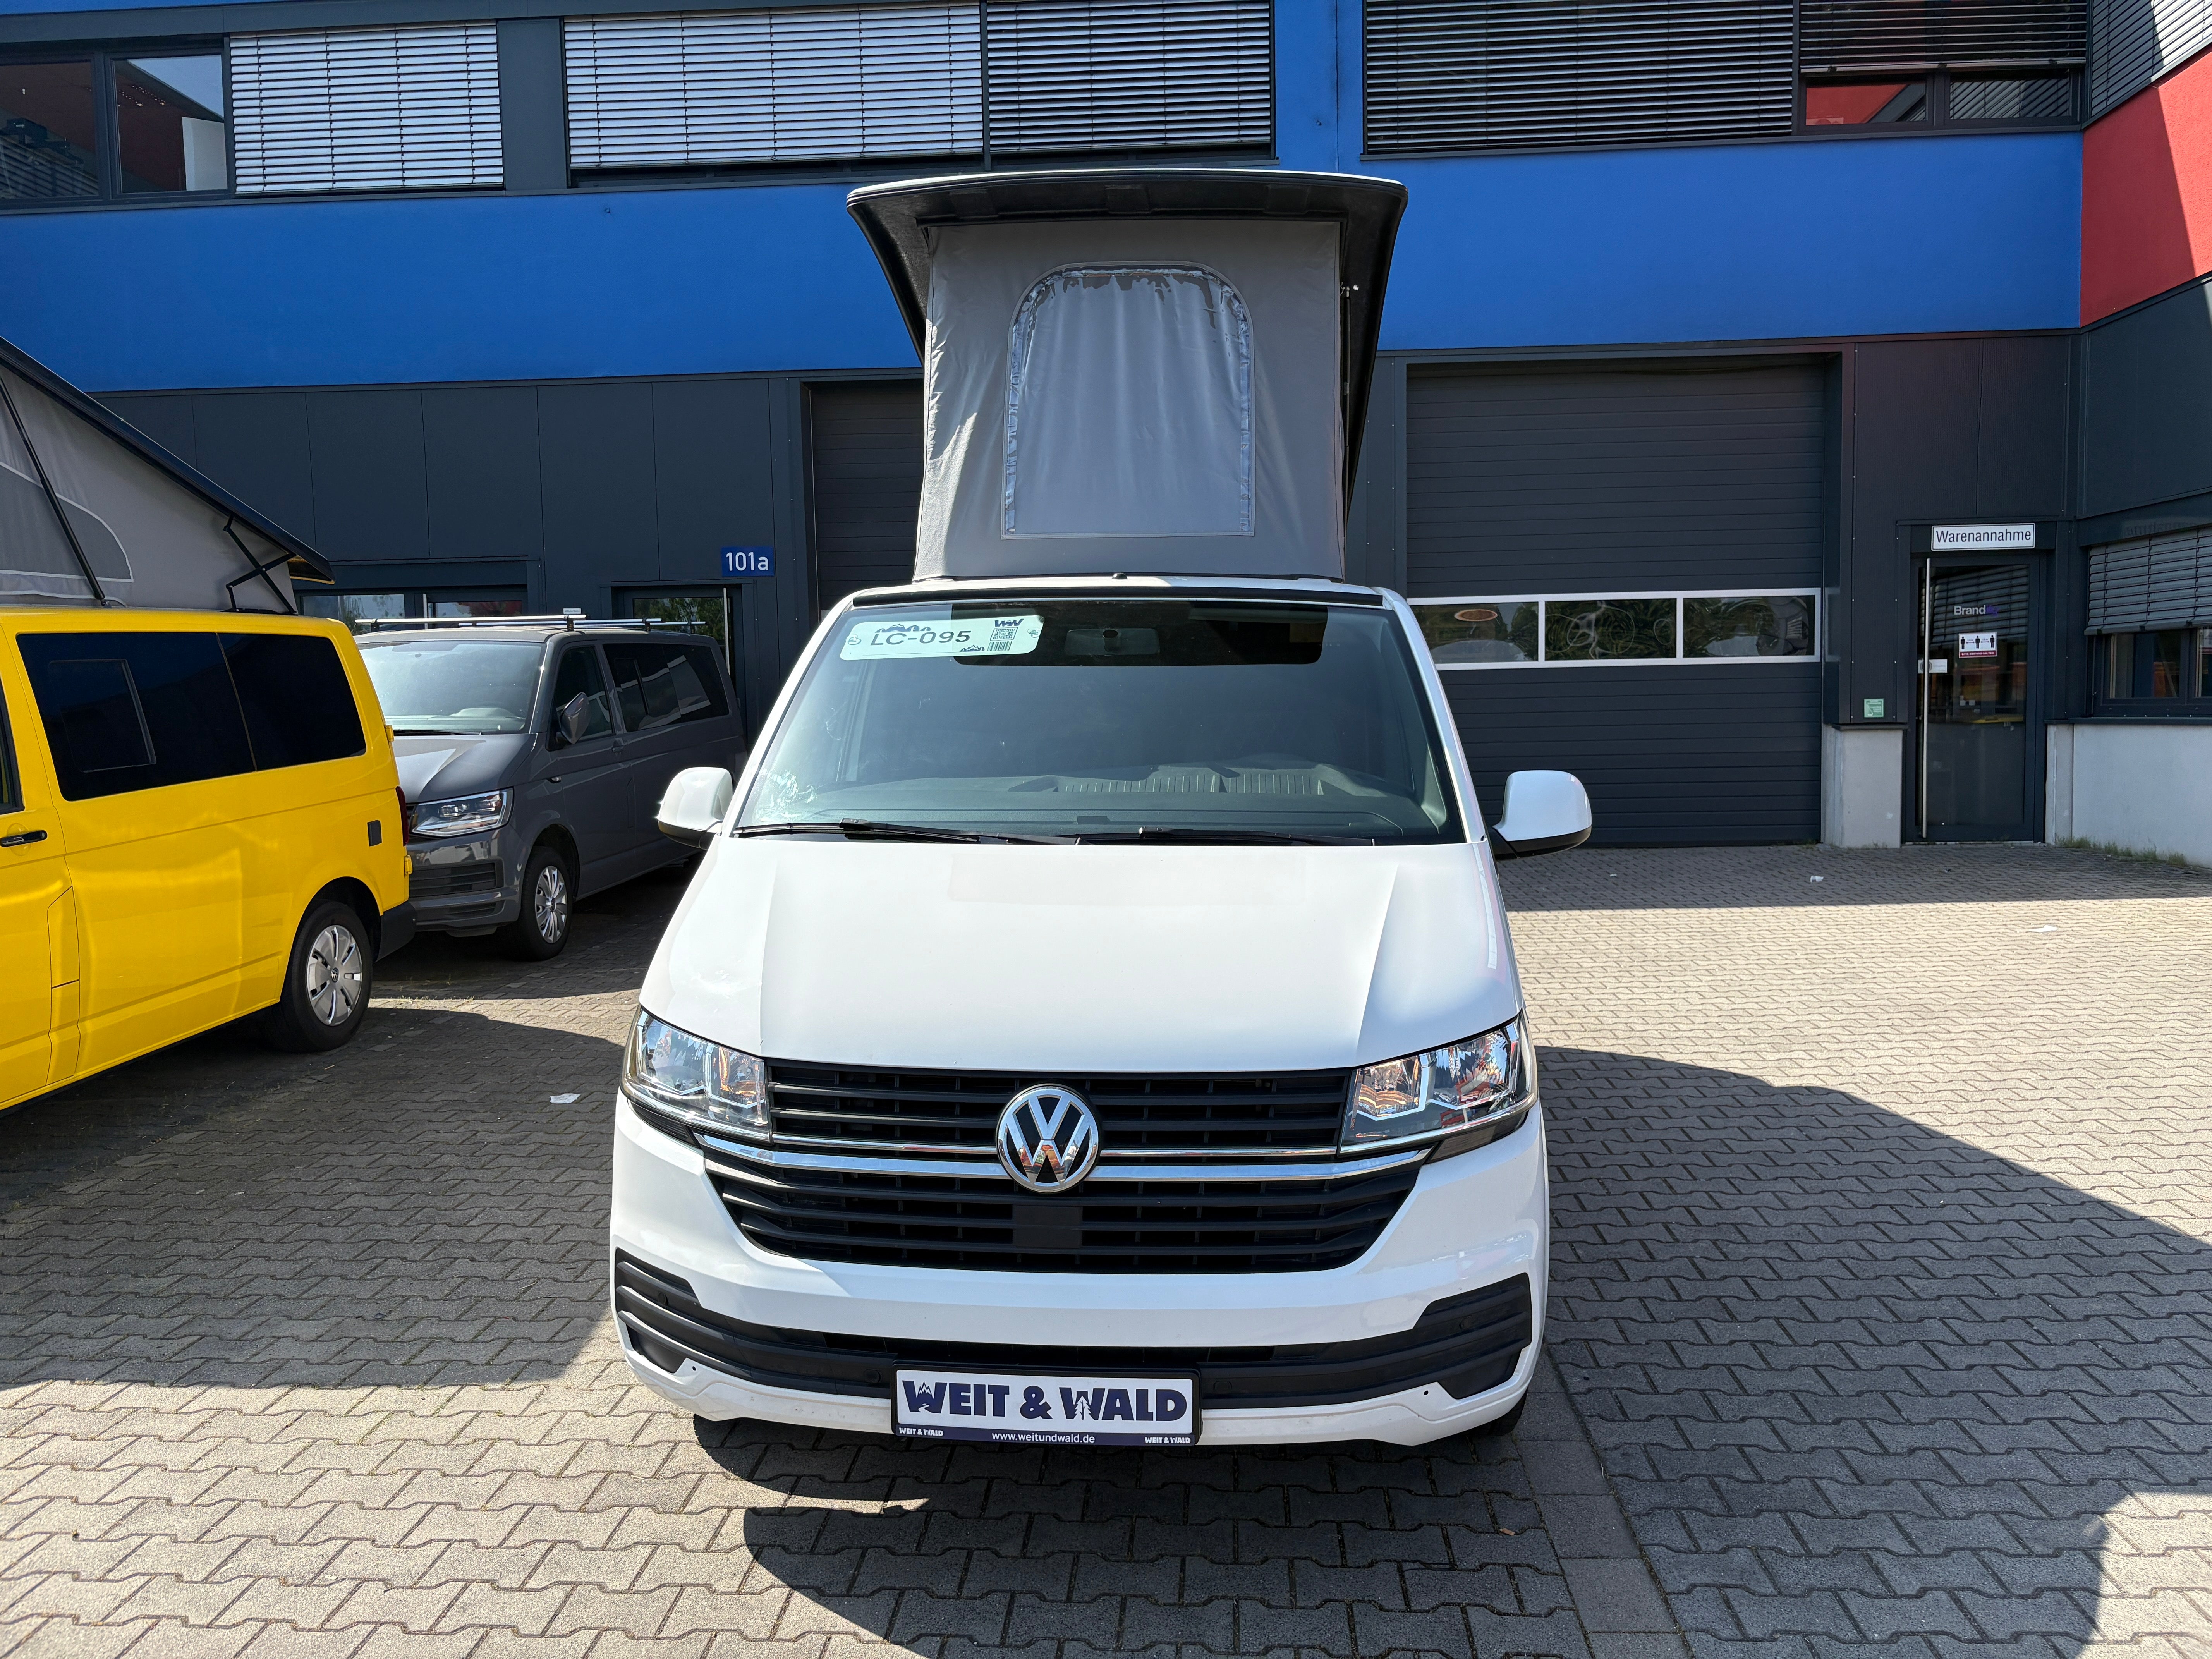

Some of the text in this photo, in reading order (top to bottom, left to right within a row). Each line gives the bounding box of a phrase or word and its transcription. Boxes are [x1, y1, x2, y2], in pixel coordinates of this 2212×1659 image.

[1936, 529, 2031, 543] Warenannahme
[726, 552, 769, 571] 101a
[871, 630, 971, 646] LC-095
[902, 1380, 1187, 1421] WEIT & WALD
[992, 1433, 1095, 1443] www.weitundwald.de
